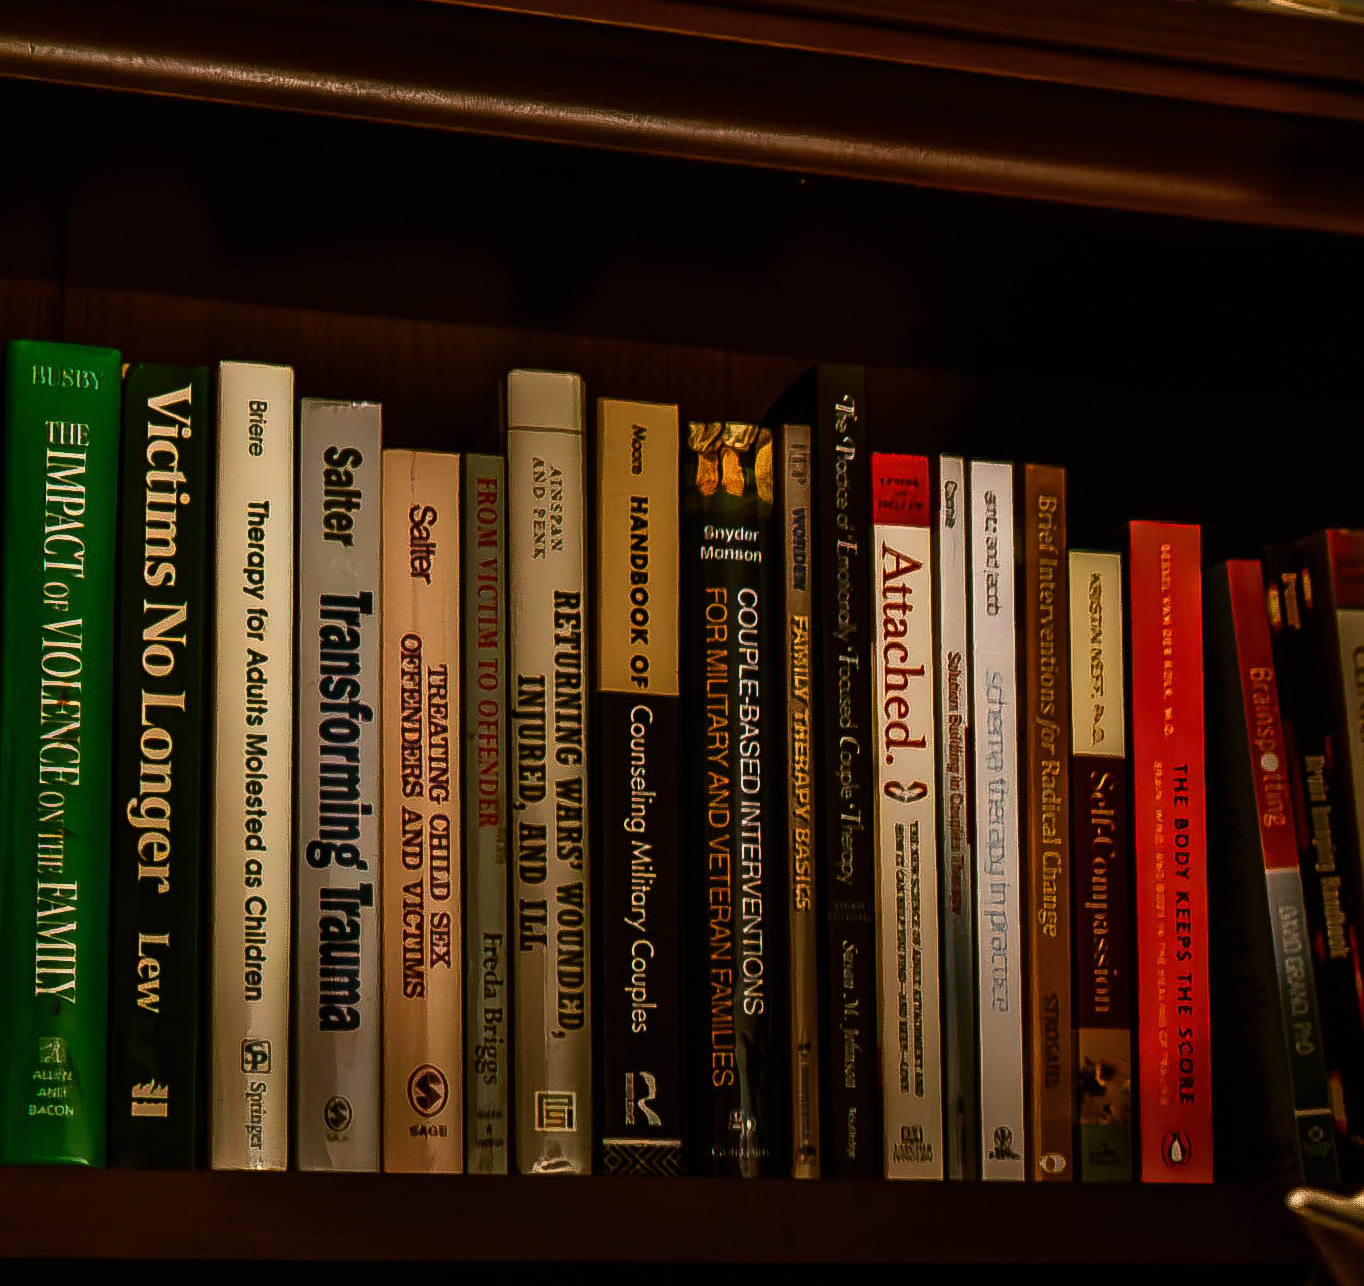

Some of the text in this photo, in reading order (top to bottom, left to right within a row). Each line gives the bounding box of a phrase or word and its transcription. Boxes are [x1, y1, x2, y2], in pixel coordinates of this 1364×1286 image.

[248, 400, 268, 459] Briere
[322, 444, 363, 549] Salter
[409, 505, 438, 585] Salter
[34, 420, 90, 1004] THE IMPACT OF VIOLENCE ON THE FAMILY
[126, 383, 192, 896] Victims No Longer
[476, 476, 500, 829] FROM VICTIM TO OFFENDER
[553, 589, 583, 767] RETURNING
[629, 495, 650, 690] HANDBOOK OF
[880, 541, 928, 765] Attached.
[1035, 494, 1063, 938] Brief Interventions for Radical Change
[242, 500, 270, 1003] Therapy for Adults Molested as Children
[306, 590, 374, 1033] Transforming Trauma
[400, 633, 425, 1001] OFFENDERS AND VICTIMS
[427, 663, 452, 970] TREATING CHILD SEX
[513, 673, 549, 954] INJURED, AND ILL
[623, 703, 659, 1035] Counseling Military Couples
[704, 586, 735, 1090] FOR MILITARY AND VETERAN FAMILIES
[736, 587, 765, 1017] COUPLE-BASED INTERVENTIONS
[792, 615, 812, 914] FAMILY THERAPY BASICS
[136, 930, 171, 1015] Lew
[474, 1007, 504, 1087] Briggs
[482, 932, 505, 1000] Freda
[552, 881, 585, 1040] WOUNDED,
[1172, 763, 1195, 1106] THE BODY KEEPS THE SCORE
